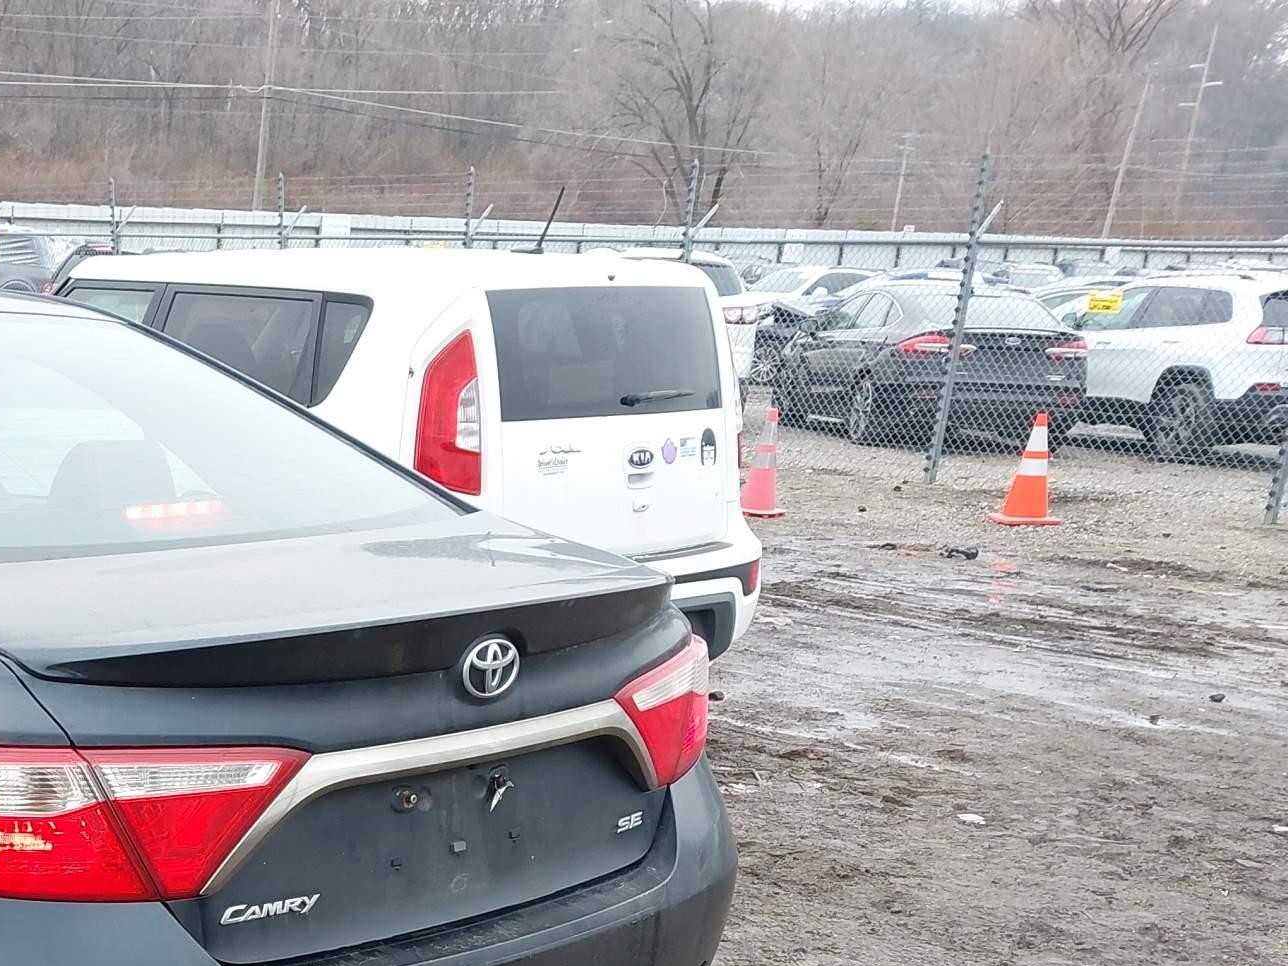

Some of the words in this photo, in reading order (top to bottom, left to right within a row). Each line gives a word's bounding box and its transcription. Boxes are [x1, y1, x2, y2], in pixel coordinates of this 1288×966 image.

[631, 450, 653, 466] KIA
[617, 811, 643, 834] SE
[220, 894, 321, 926] CAMRY
